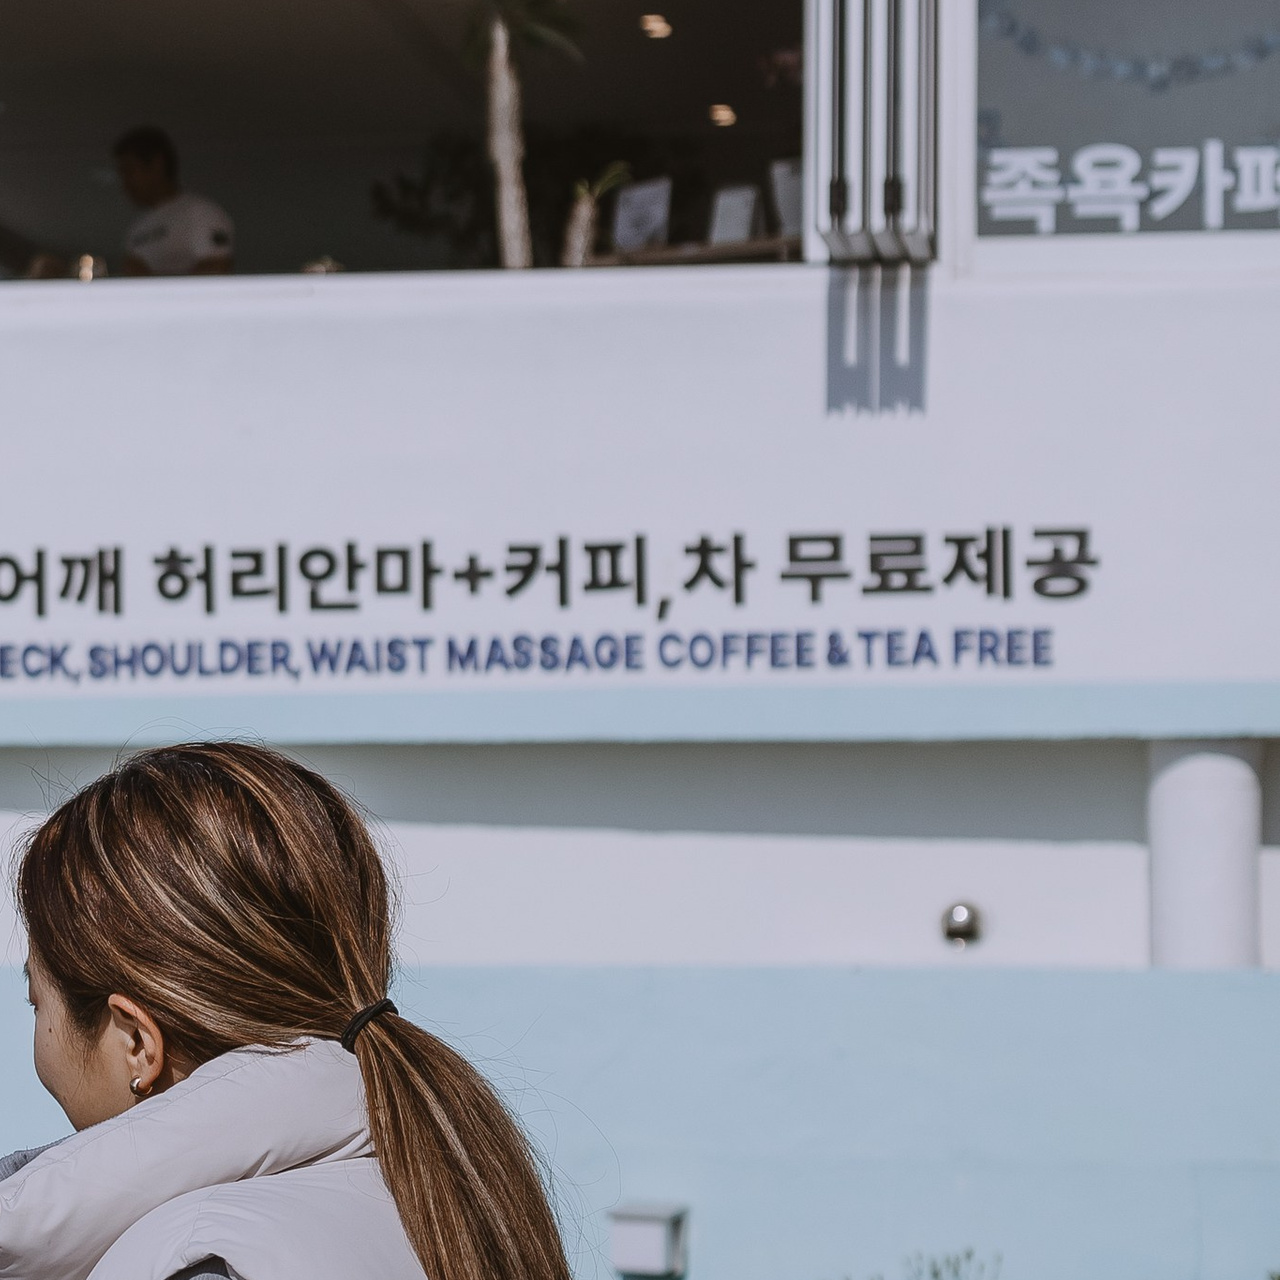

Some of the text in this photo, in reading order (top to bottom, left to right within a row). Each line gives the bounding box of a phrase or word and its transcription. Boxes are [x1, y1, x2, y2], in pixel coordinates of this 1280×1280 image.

[779, 524, 1099, 606] 무료제공
[445, 631, 643, 674] MASSAGE
[952, 626, 1053, 668] FREE
